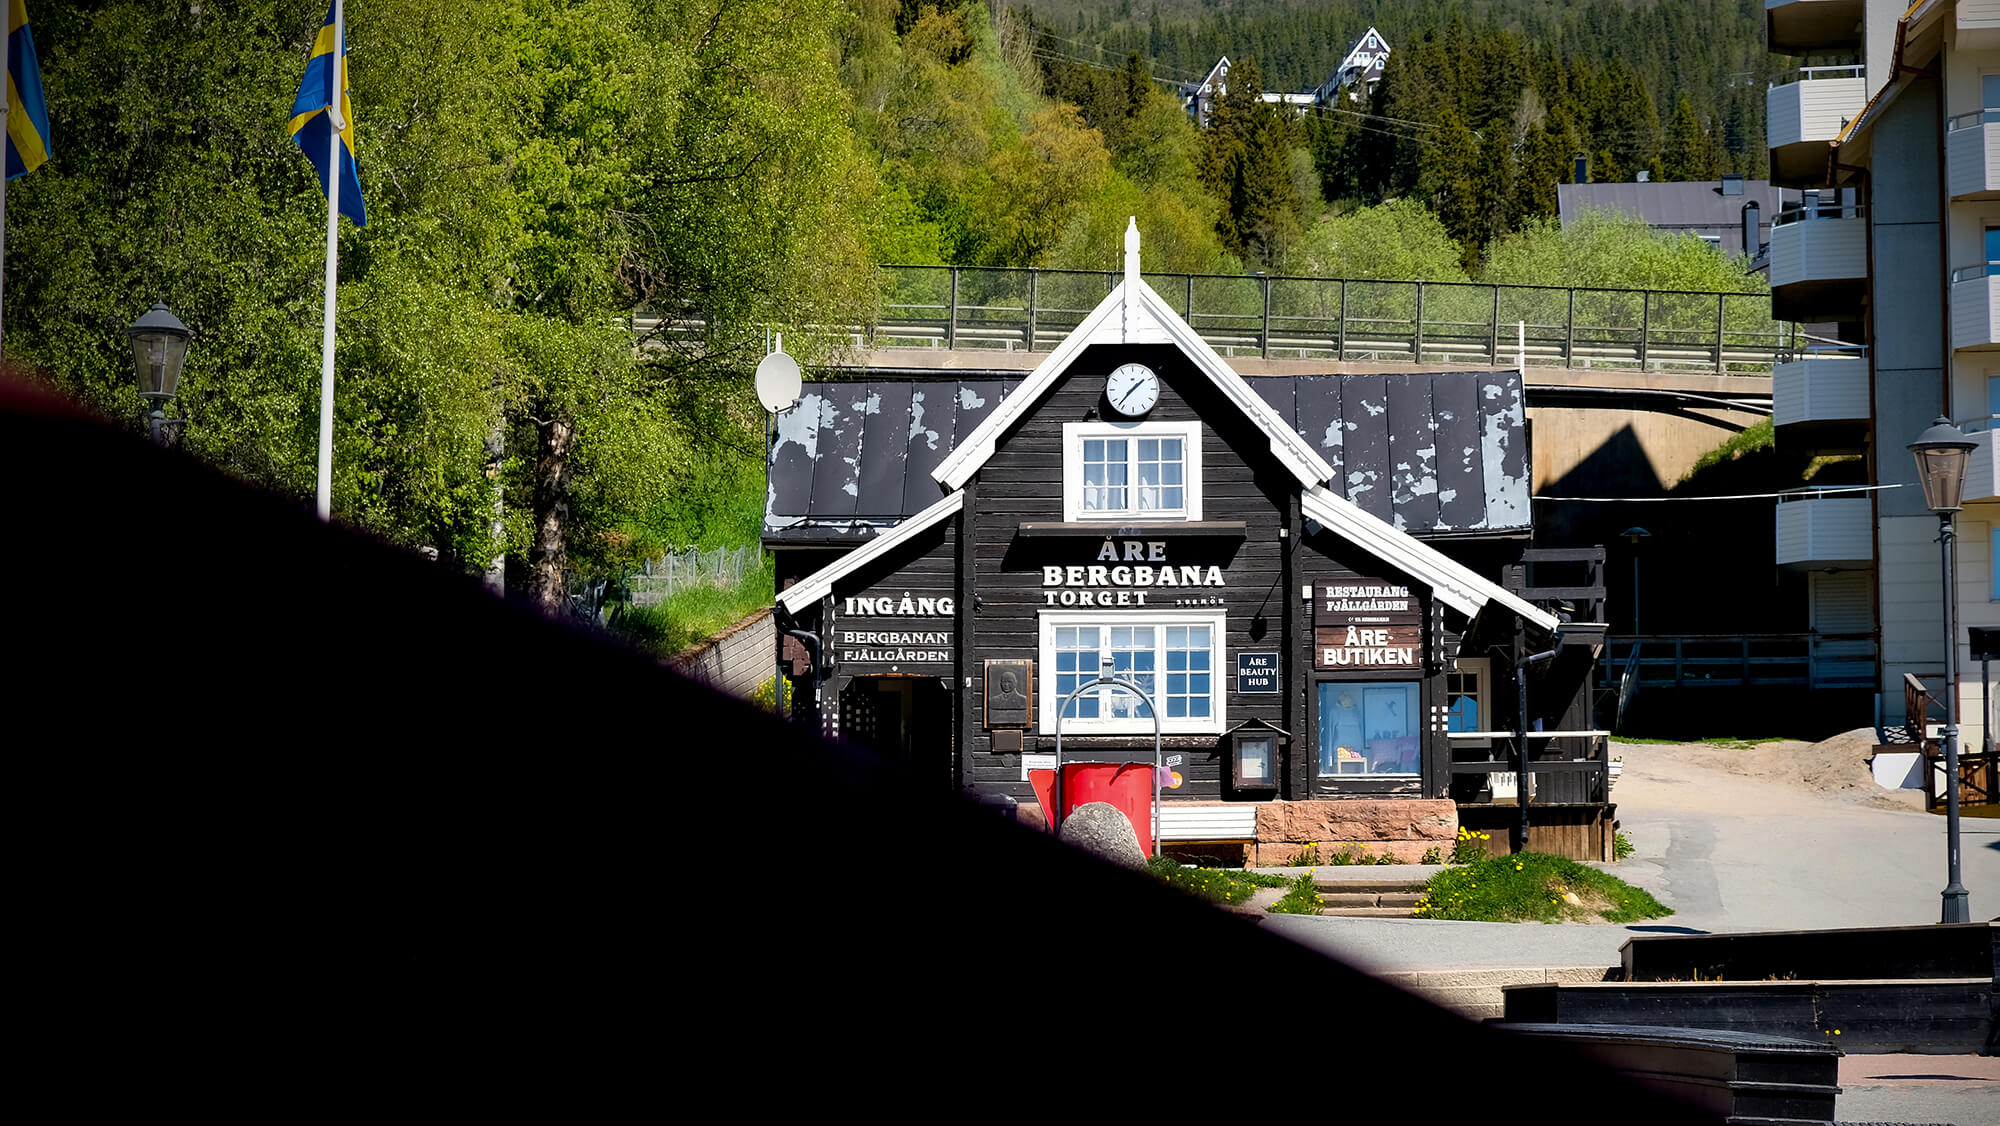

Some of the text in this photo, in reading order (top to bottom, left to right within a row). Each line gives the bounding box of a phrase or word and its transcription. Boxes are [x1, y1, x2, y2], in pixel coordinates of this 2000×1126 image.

[1097, 535, 1167, 561] ÅRE
[1042, 566, 1226, 587] BERGBANA
[1043, 590, 1148, 606] TORGET
[1325, 586, 1409, 598] RESTAURANG
[844, 591, 955, 615] INGÅNG
[1326, 598, 1409, 611] FJÄLLGÅRDEN
[844, 632, 948, 644] BERGBANAN
[1344, 625, 1394, 647] ÅRE-
[844, 648, 949, 661] FJÄLLGÅRDEN
[1323, 647, 1413, 665] BUTIKEN
[1240, 667, 1277, 676] BEAUTY
[1248, 678, 1269, 686] HUB
